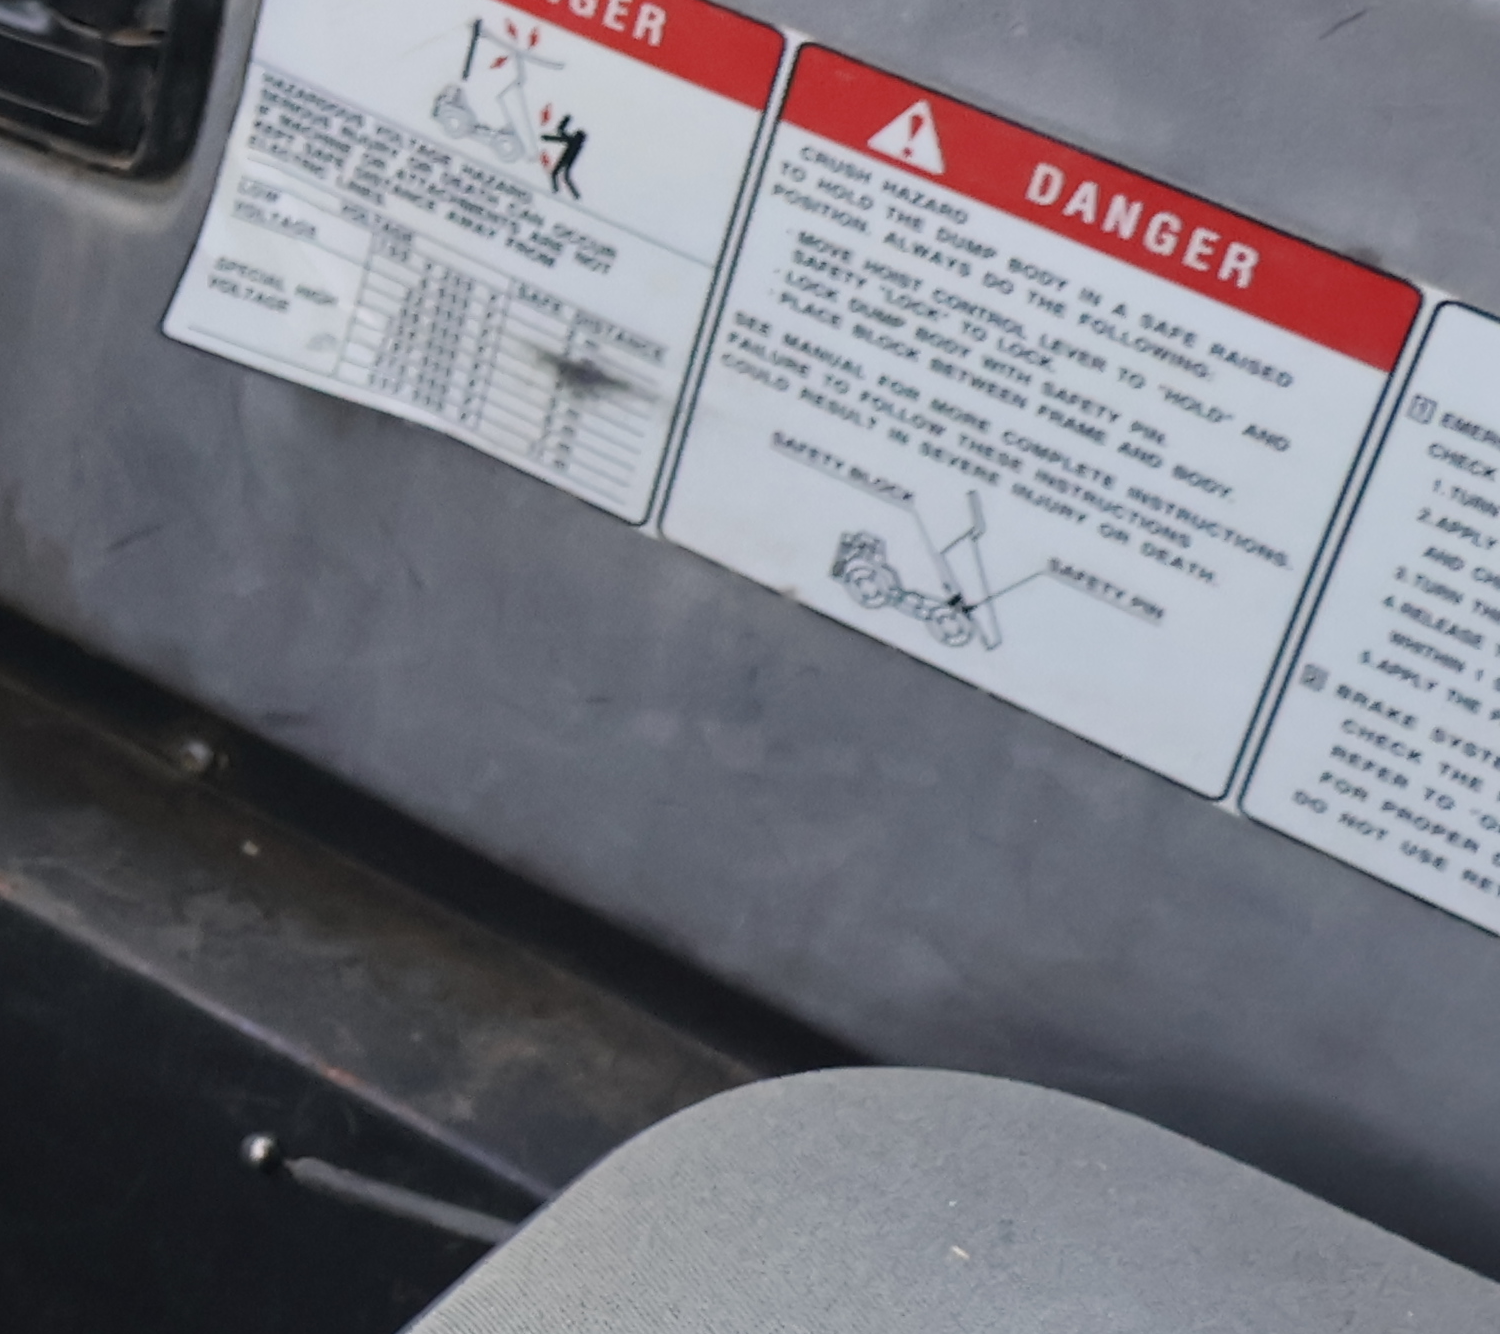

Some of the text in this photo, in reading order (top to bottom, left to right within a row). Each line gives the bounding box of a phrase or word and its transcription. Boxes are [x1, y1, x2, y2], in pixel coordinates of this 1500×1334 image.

[799, 145, 968, 225] CRUSH HAZARD
[1024, 161, 1262, 290] DANGER
[780, 160, 1293, 387] TO HOLD THE DUMP BODY IN A SAFE RAISED
[792, 249, 867, 288] SAFETY
[961, 319, 988, 342] TO
[883, 231, 971, 277] ALWAYS
[981, 270, 1014, 295] DO
[1027, 289, 1067, 318] THE
[733, 310, 772, 337] SEE
[781, 332, 863, 379] MANUAL
[876, 374, 920, 401] FOR
[928, 397, 990, 433] MORE
[1001, 430, 1115, 489] COMPLETE
[778, 290, 842, 329] PLACE
[851, 322, 920, 362] BLOCK
[929, 357, 1027, 409] BETWEEN
[1036, 403, 1107, 445] FRAME
[1116, 441, 1164, 469] AND
[784, 270, 839, 302] LOCK
[847, 297, 906, 328] DUMP
[913, 325, 971, 358] BODY
[981, 354, 1032, 386] WITH
[1040, 380, 1121, 423] SAFETY
[797, 230, 853, 271] MOVE
[861, 259, 923, 296] HOIST
[931, 287, 1026, 340] CONTROL
[1038, 333, 1107, 372] LEVER
[1117, 366, 1146, 389] TO
[1241, 423, 1291, 452] AND
[720, 352, 789, 392] COULD
[798, 386, 877, 429] RESULT
[886, 426, 910, 446] IN
[918, 440, 1000, 486] SEVERE
[1011, 482, 1087, 523] INJURY
[1097, 522, 1130, 545] OR
[726, 331, 1191, 548] FAILURE TO FOLLOW THESE INSTRUCTIONS
[1329, 744, 1409, 789] REFER
[1334, 683, 1418, 729] BRAKE
[1340, 718, 1422, 764] CHECK
[1318, 770, 1369, 802] FOR
[1380, 799, 1479, 853] PROPER
